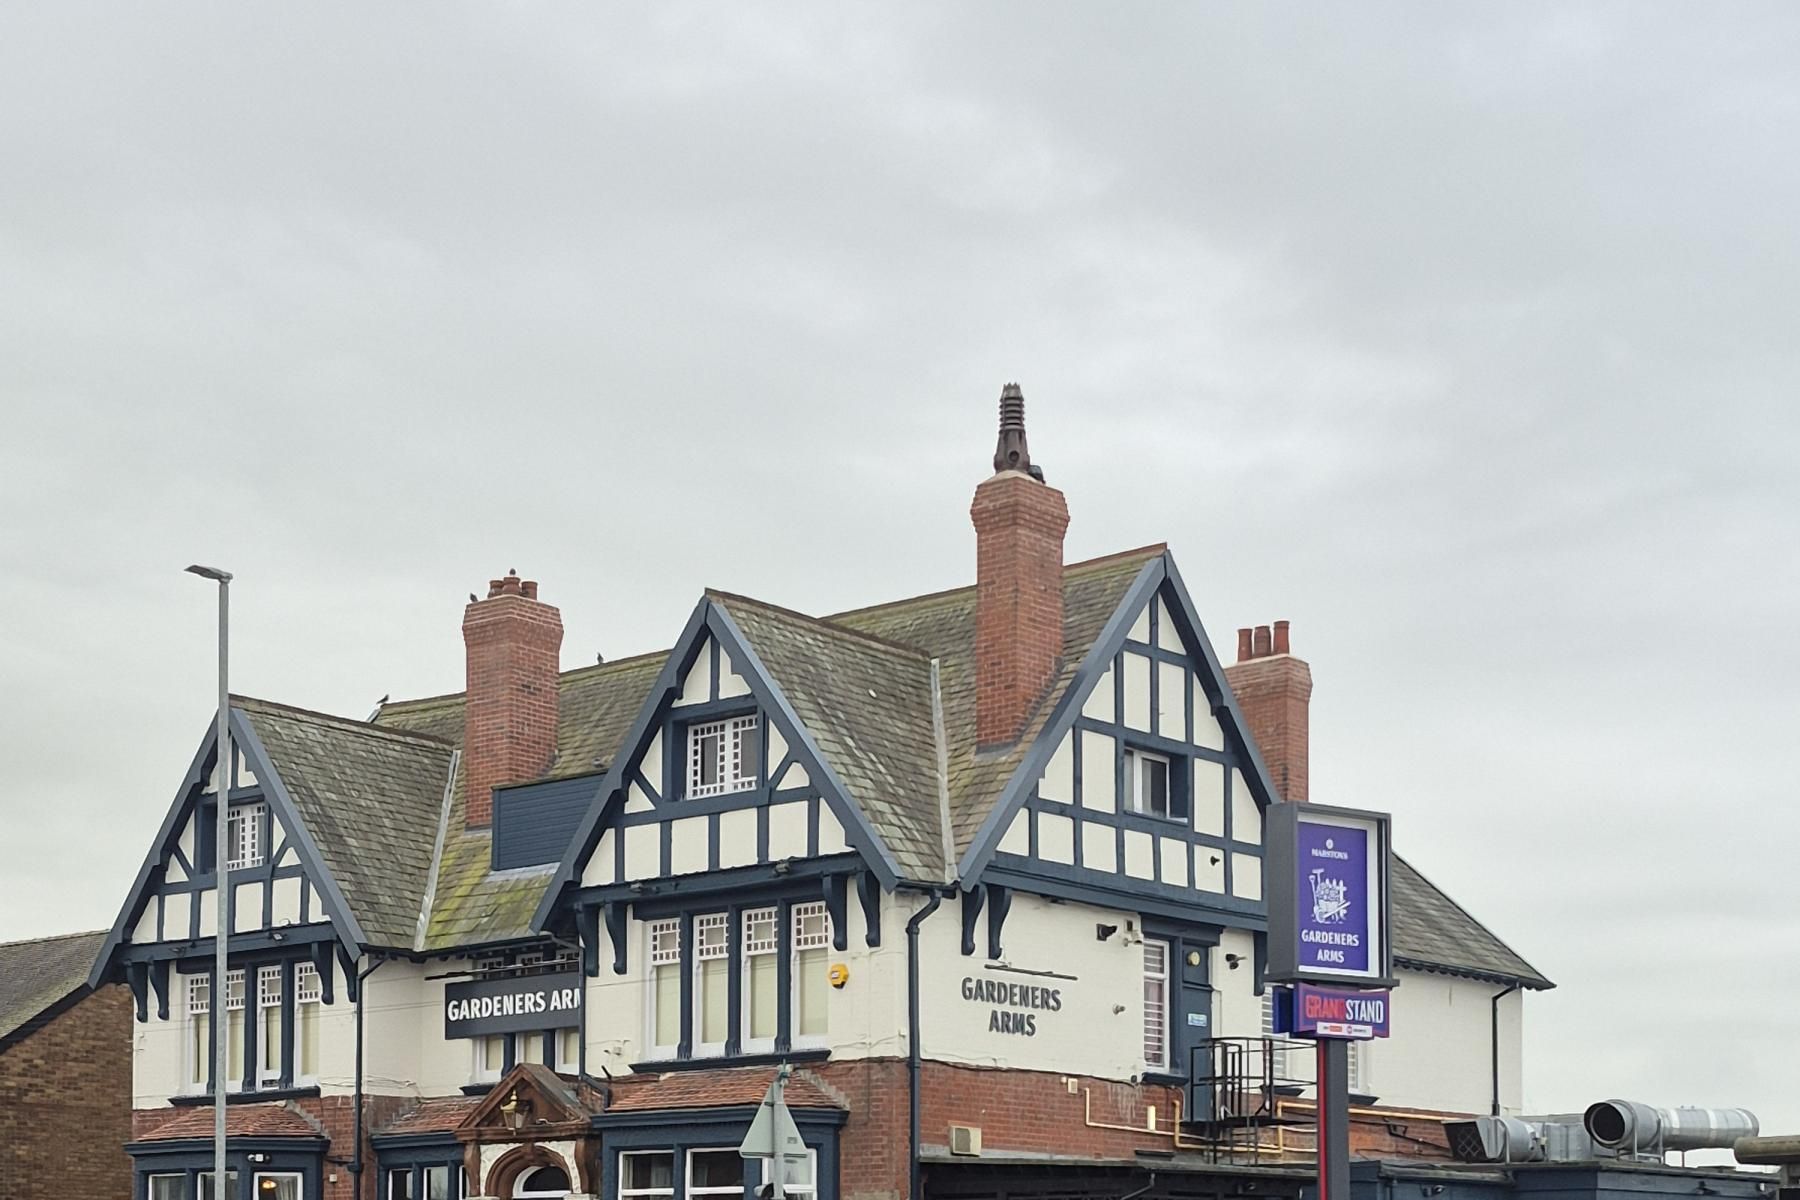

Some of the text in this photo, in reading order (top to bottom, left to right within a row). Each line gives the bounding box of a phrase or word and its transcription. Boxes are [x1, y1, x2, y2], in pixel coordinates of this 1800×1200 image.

[1301, 929, 1360, 947] GARDENERS
[1317, 948, 1345, 963] ARMS
[447, 988, 581, 1022] GARDENERS ARM
[961, 976, 1062, 1012] GARDENERS
[988, 1010, 1037, 1037] ARMS
